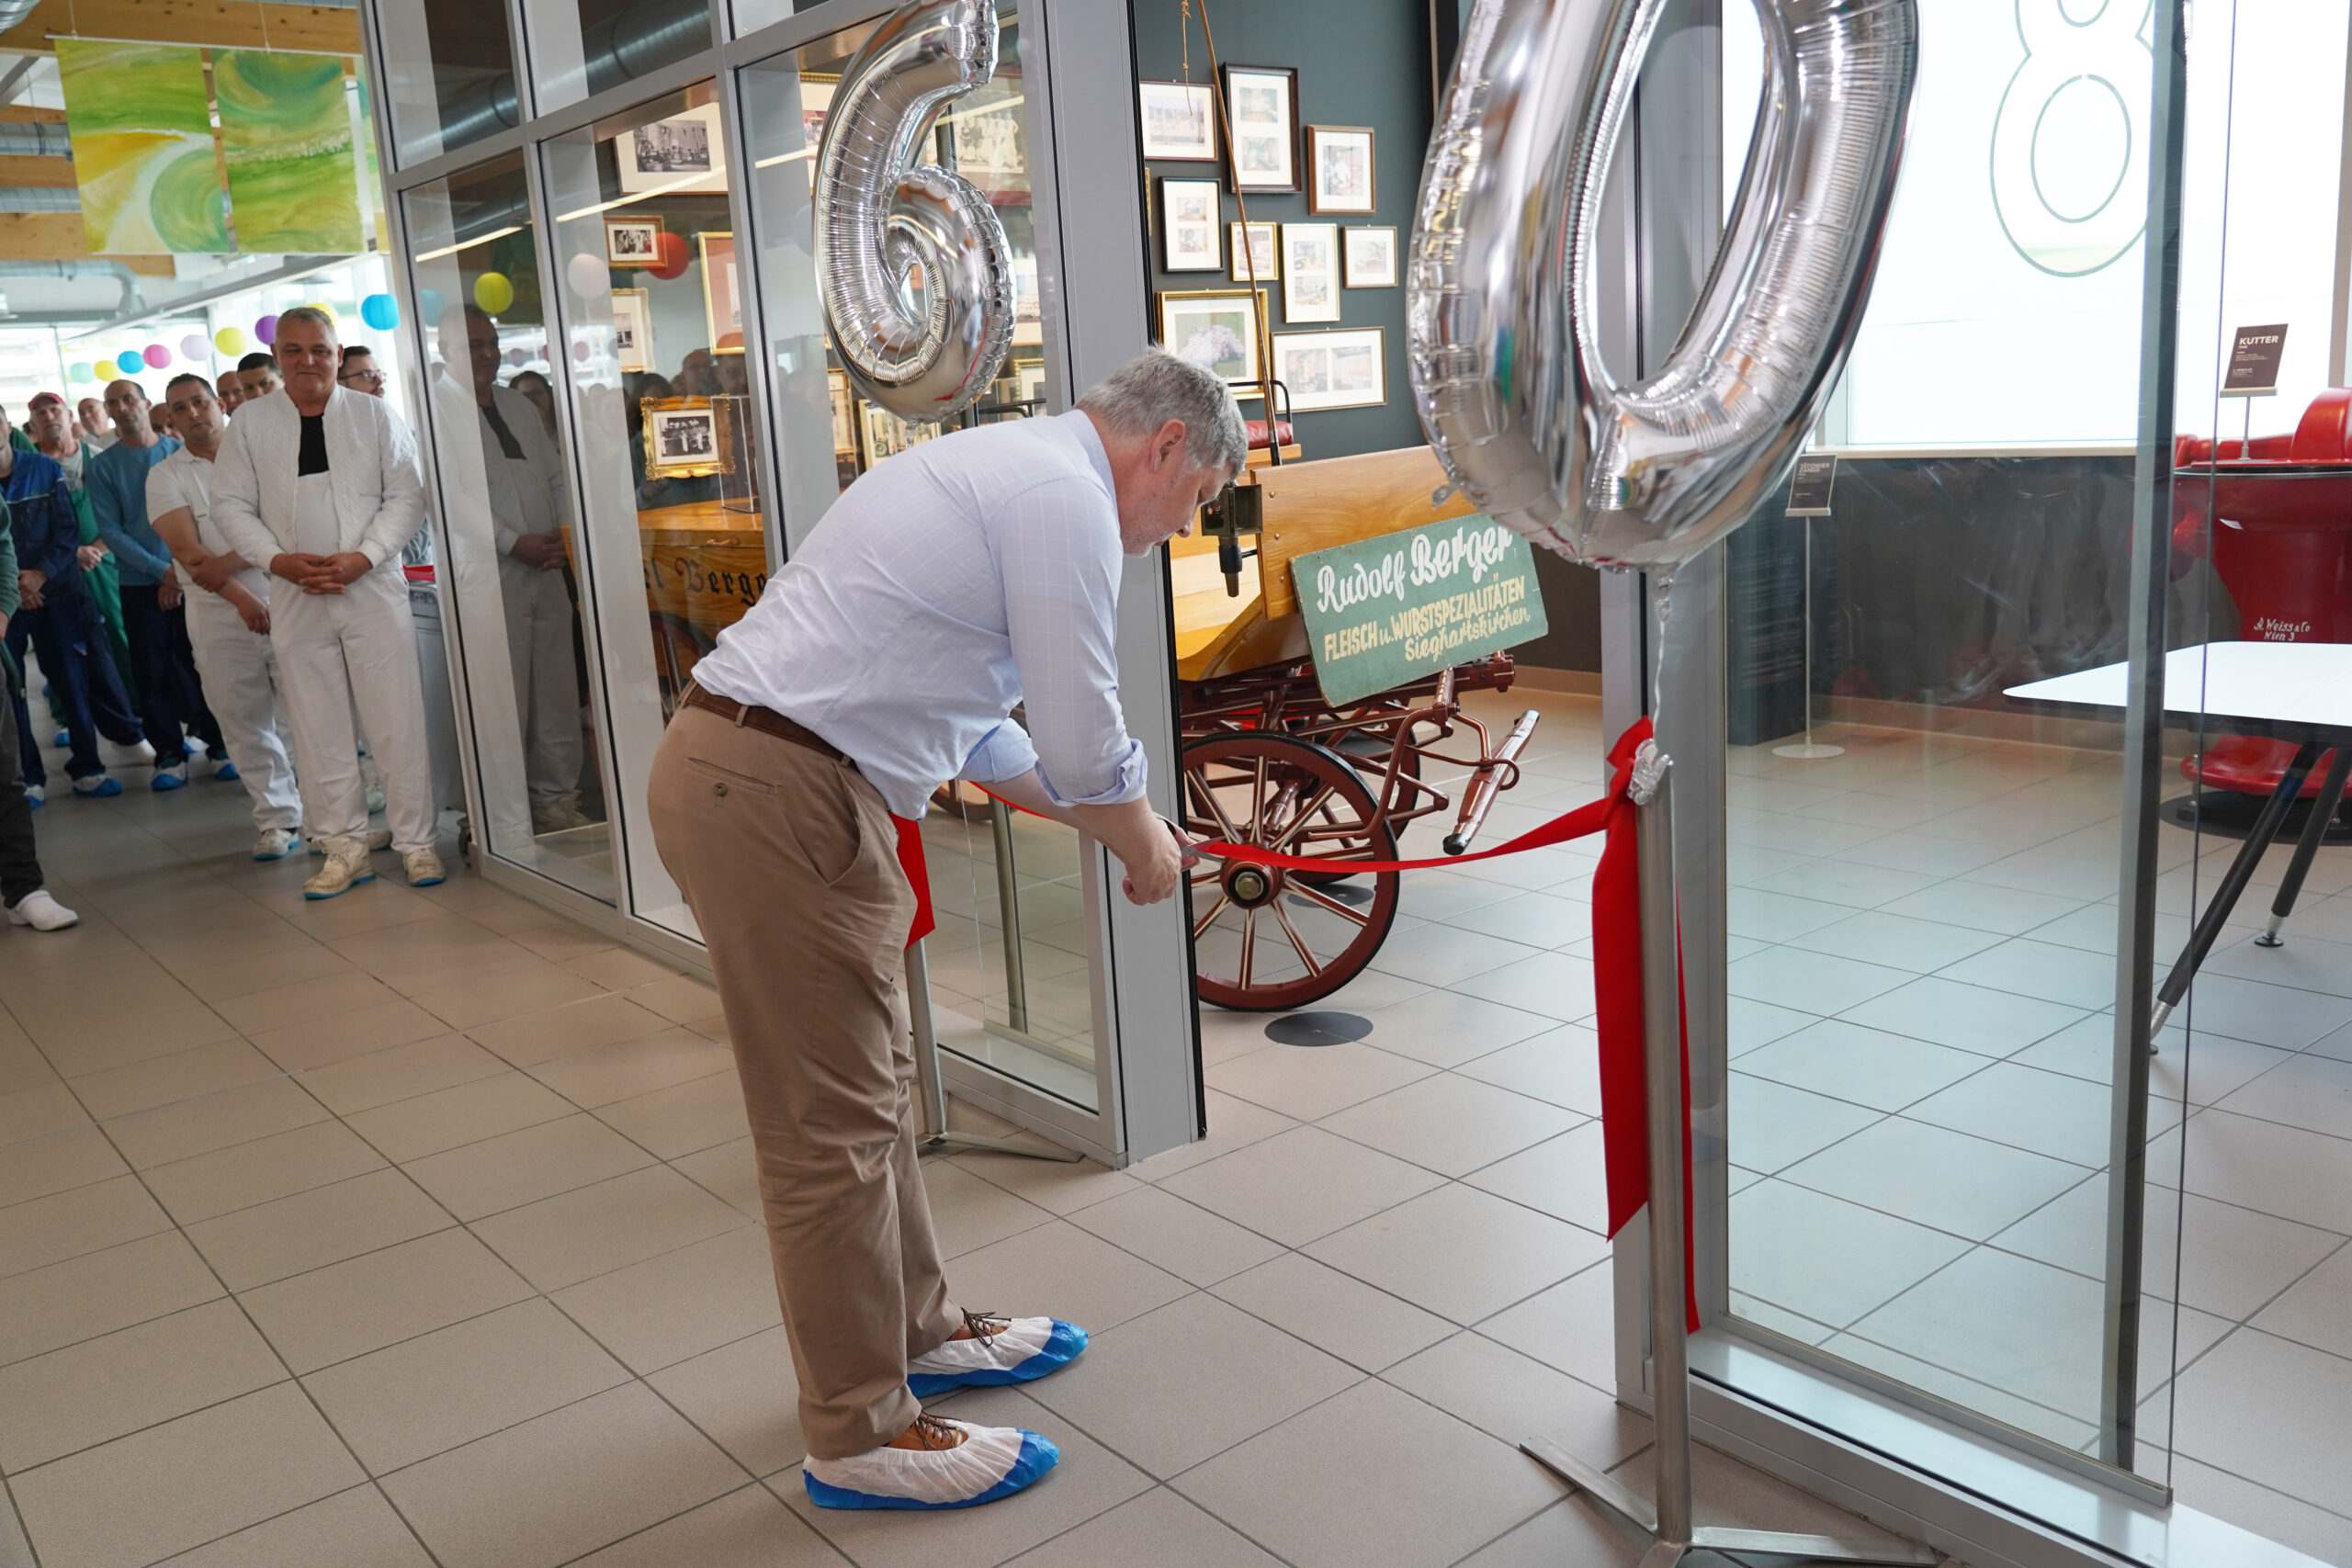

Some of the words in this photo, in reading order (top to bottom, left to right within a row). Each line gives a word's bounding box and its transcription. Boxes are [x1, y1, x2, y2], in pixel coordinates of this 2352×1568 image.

[2239, 335, 2278, 345] KUTTER
[674, 557, 768, 607] Berge
[1317, 550, 1405, 614] Rudolf
[1410, 525, 1513, 586] Berger
[1324, 621, 1377, 662] FLEISCH
[1390, 572, 1525, 640] WURSTSPEZIALITÄTEN
[1405, 607, 1531, 662] Sieghartskirchen
[2264, 631, 2286, 641] Wien
[2289, 632, 2295, 641] 3
[2266, 619, 2293, 632] Weiss
